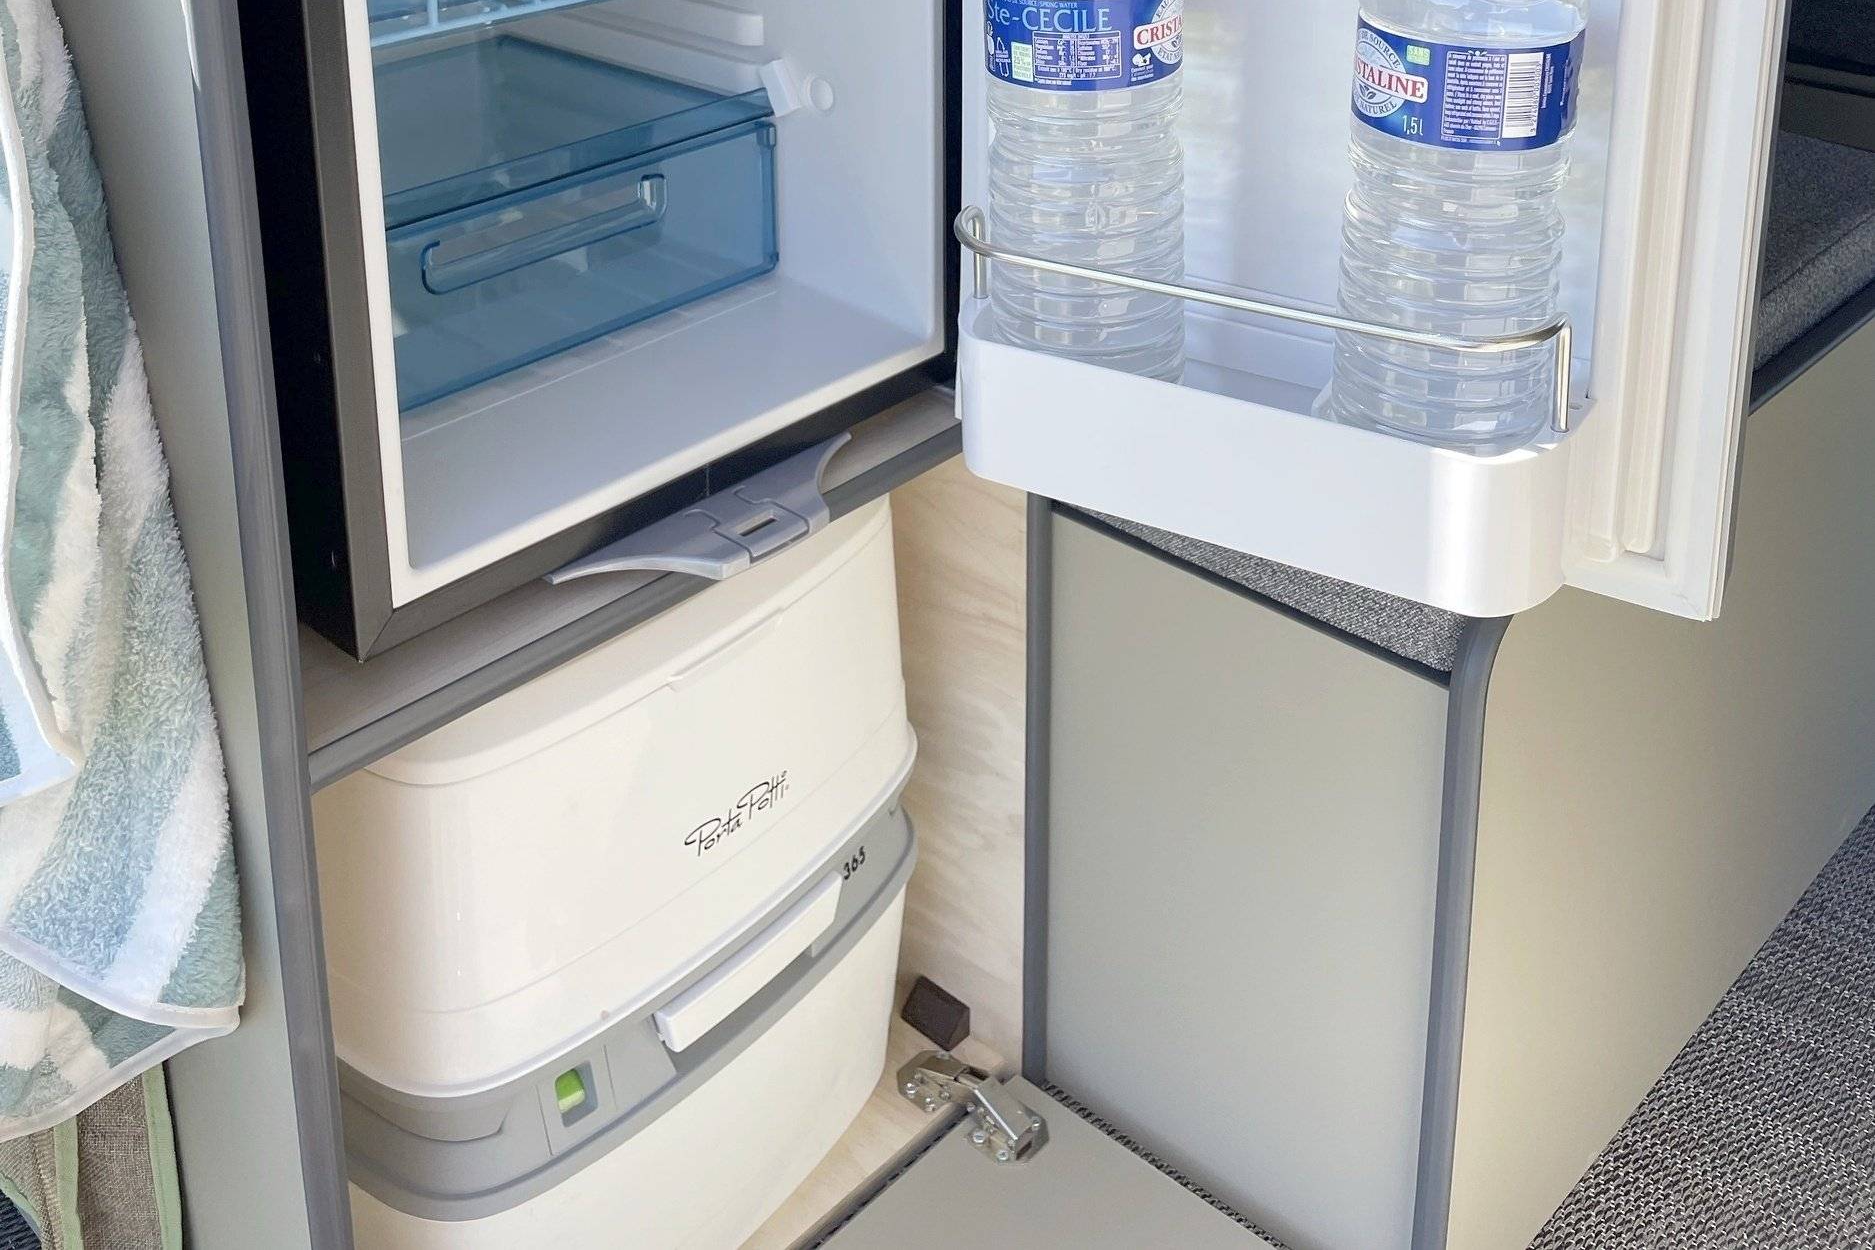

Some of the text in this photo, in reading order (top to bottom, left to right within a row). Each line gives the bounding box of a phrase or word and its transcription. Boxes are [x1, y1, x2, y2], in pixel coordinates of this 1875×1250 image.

[1369, 33, 1401, 69] SOURCE
[1359, 100, 1397, 115] NATUREL
[684, 770, 788, 857] Porta Potti
